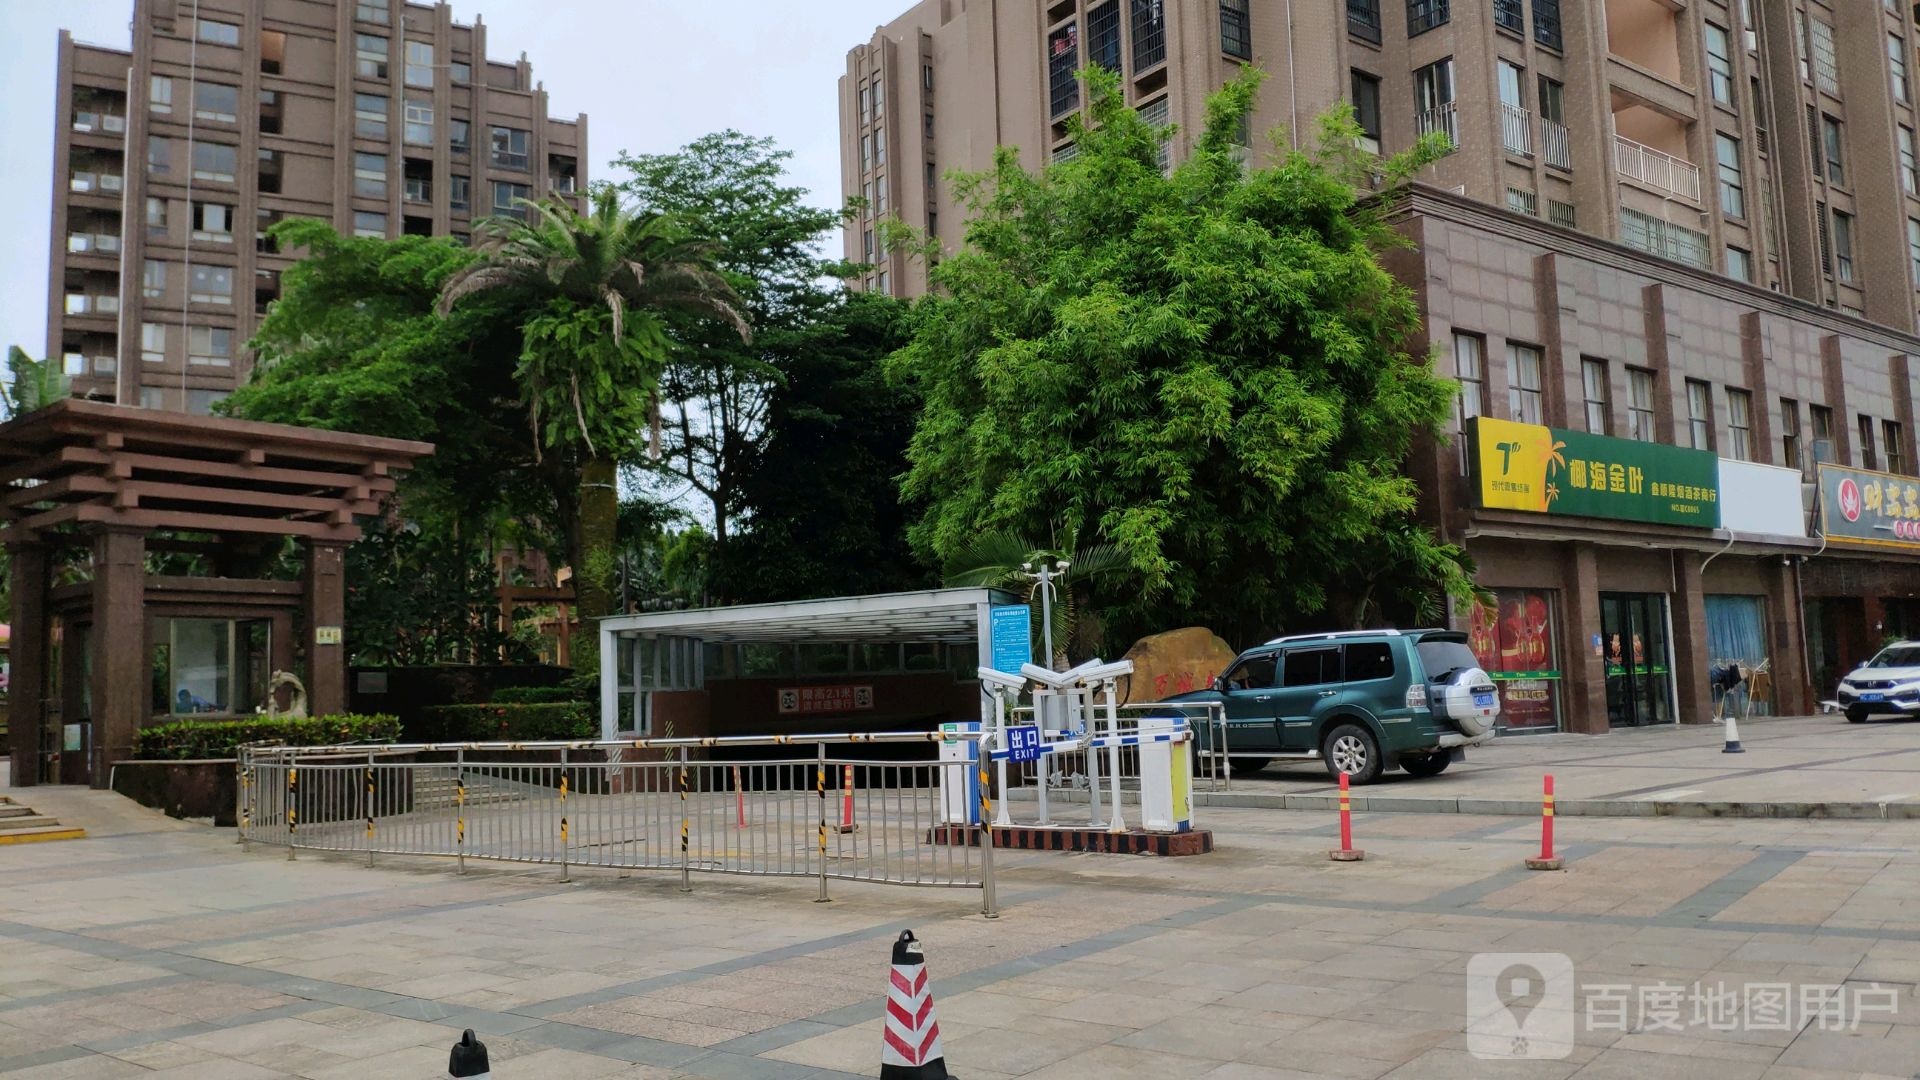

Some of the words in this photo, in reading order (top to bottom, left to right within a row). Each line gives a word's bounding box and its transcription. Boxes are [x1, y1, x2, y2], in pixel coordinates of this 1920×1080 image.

[1569, 459, 1643, 495] 椰海金叶
[1012, 730, 1038, 748] 出口
[1015, 749, 1035, 760] EXIT
